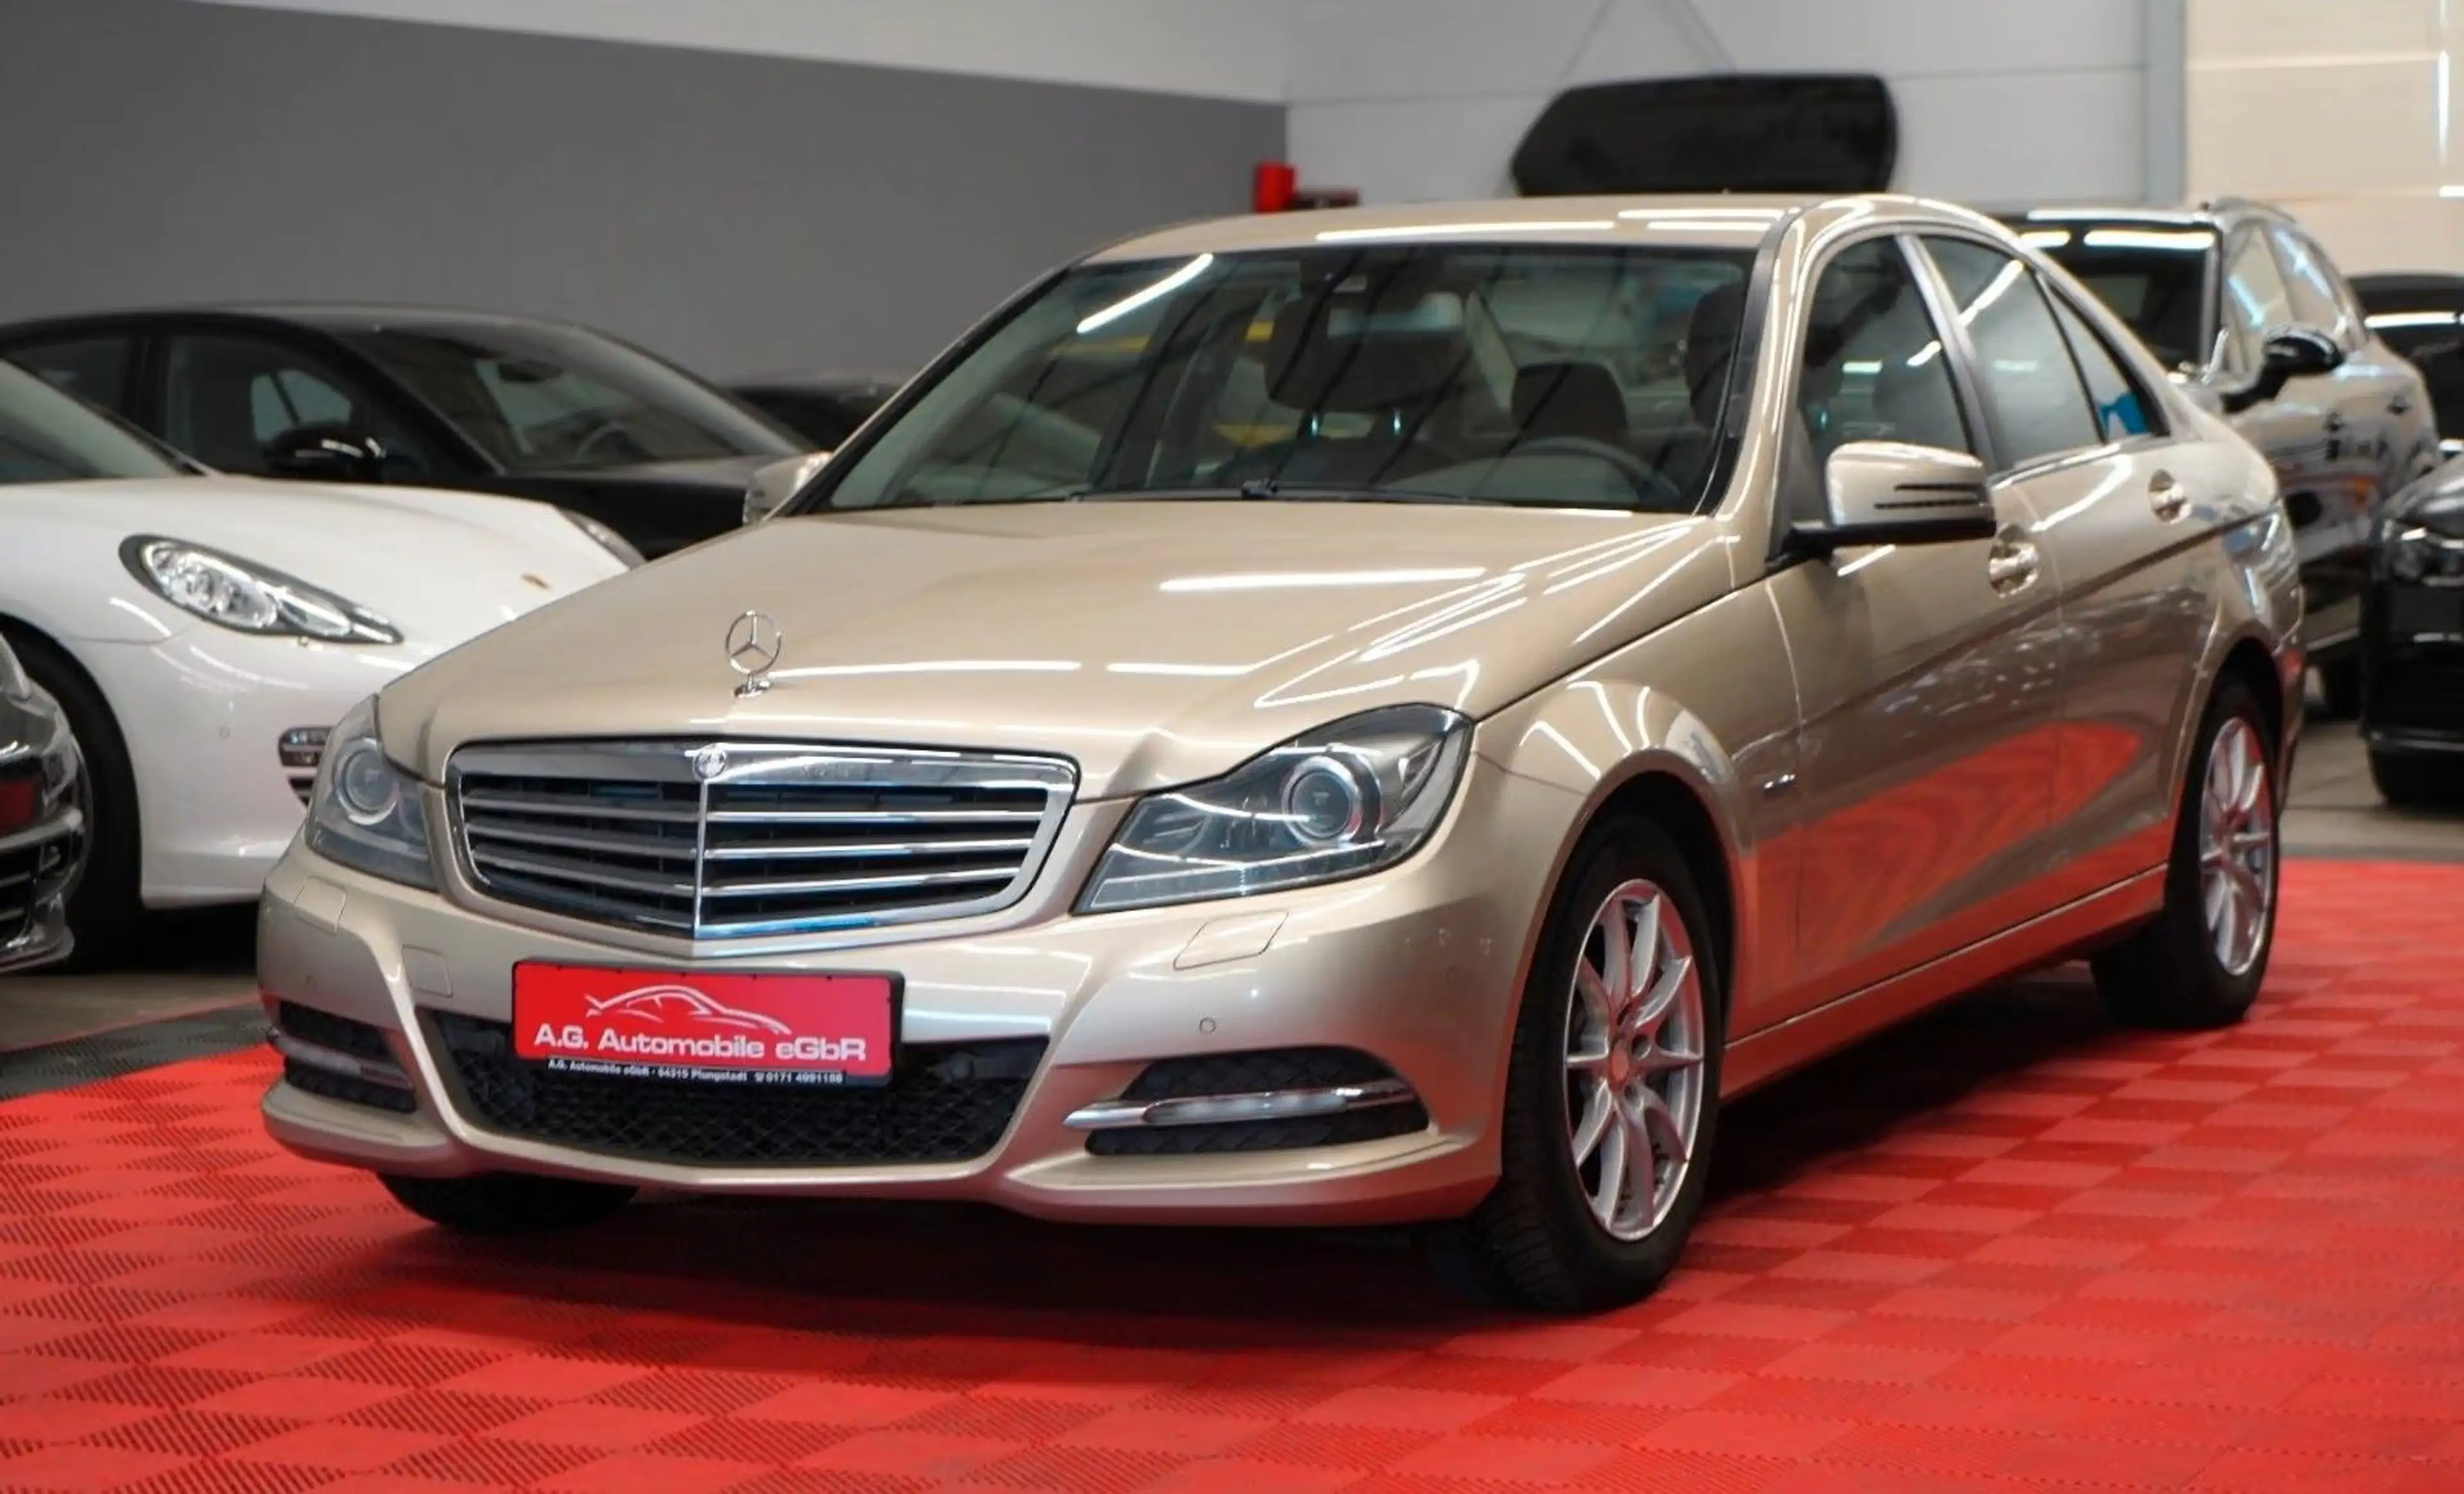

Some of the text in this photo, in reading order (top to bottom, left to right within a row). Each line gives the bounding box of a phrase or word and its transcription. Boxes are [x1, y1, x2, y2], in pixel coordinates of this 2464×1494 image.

[535, 1023, 866, 1060] A.G. Automobile eGbR
